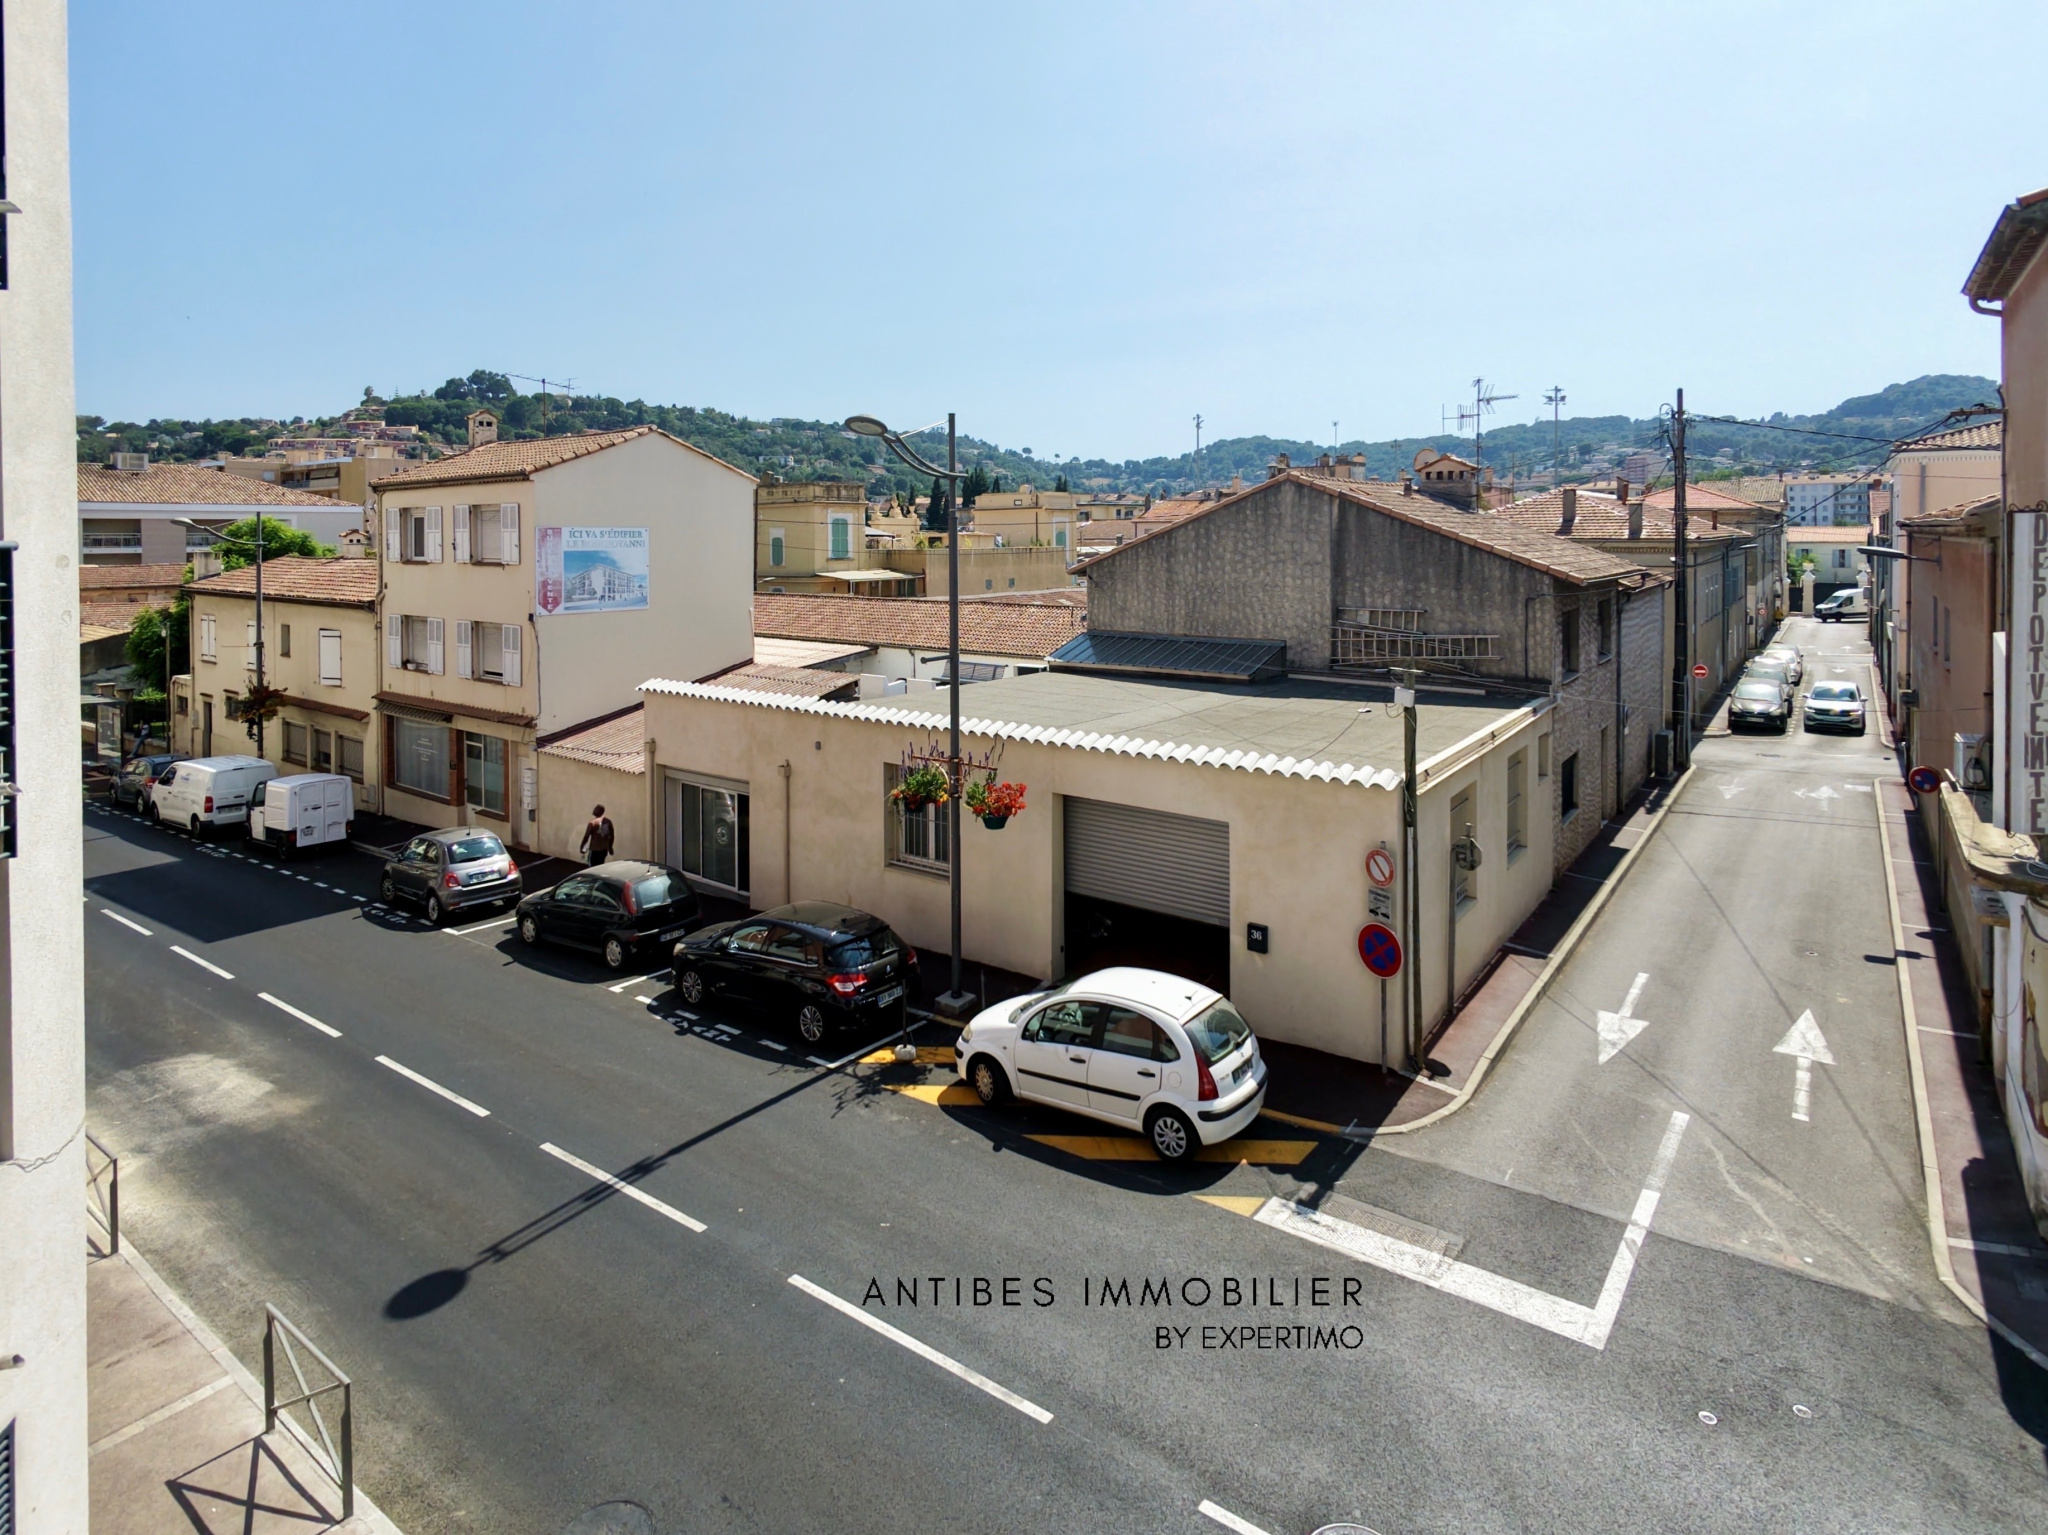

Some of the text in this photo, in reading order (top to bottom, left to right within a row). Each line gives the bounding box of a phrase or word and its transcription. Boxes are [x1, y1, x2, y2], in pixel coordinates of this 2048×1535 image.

[568, 530, 583, 539] ICI
[585, 530, 598, 539] VA
[2029, 513, 2048, 834] DEPOT VENTE
[1250, 929, 1263, 941] 36
